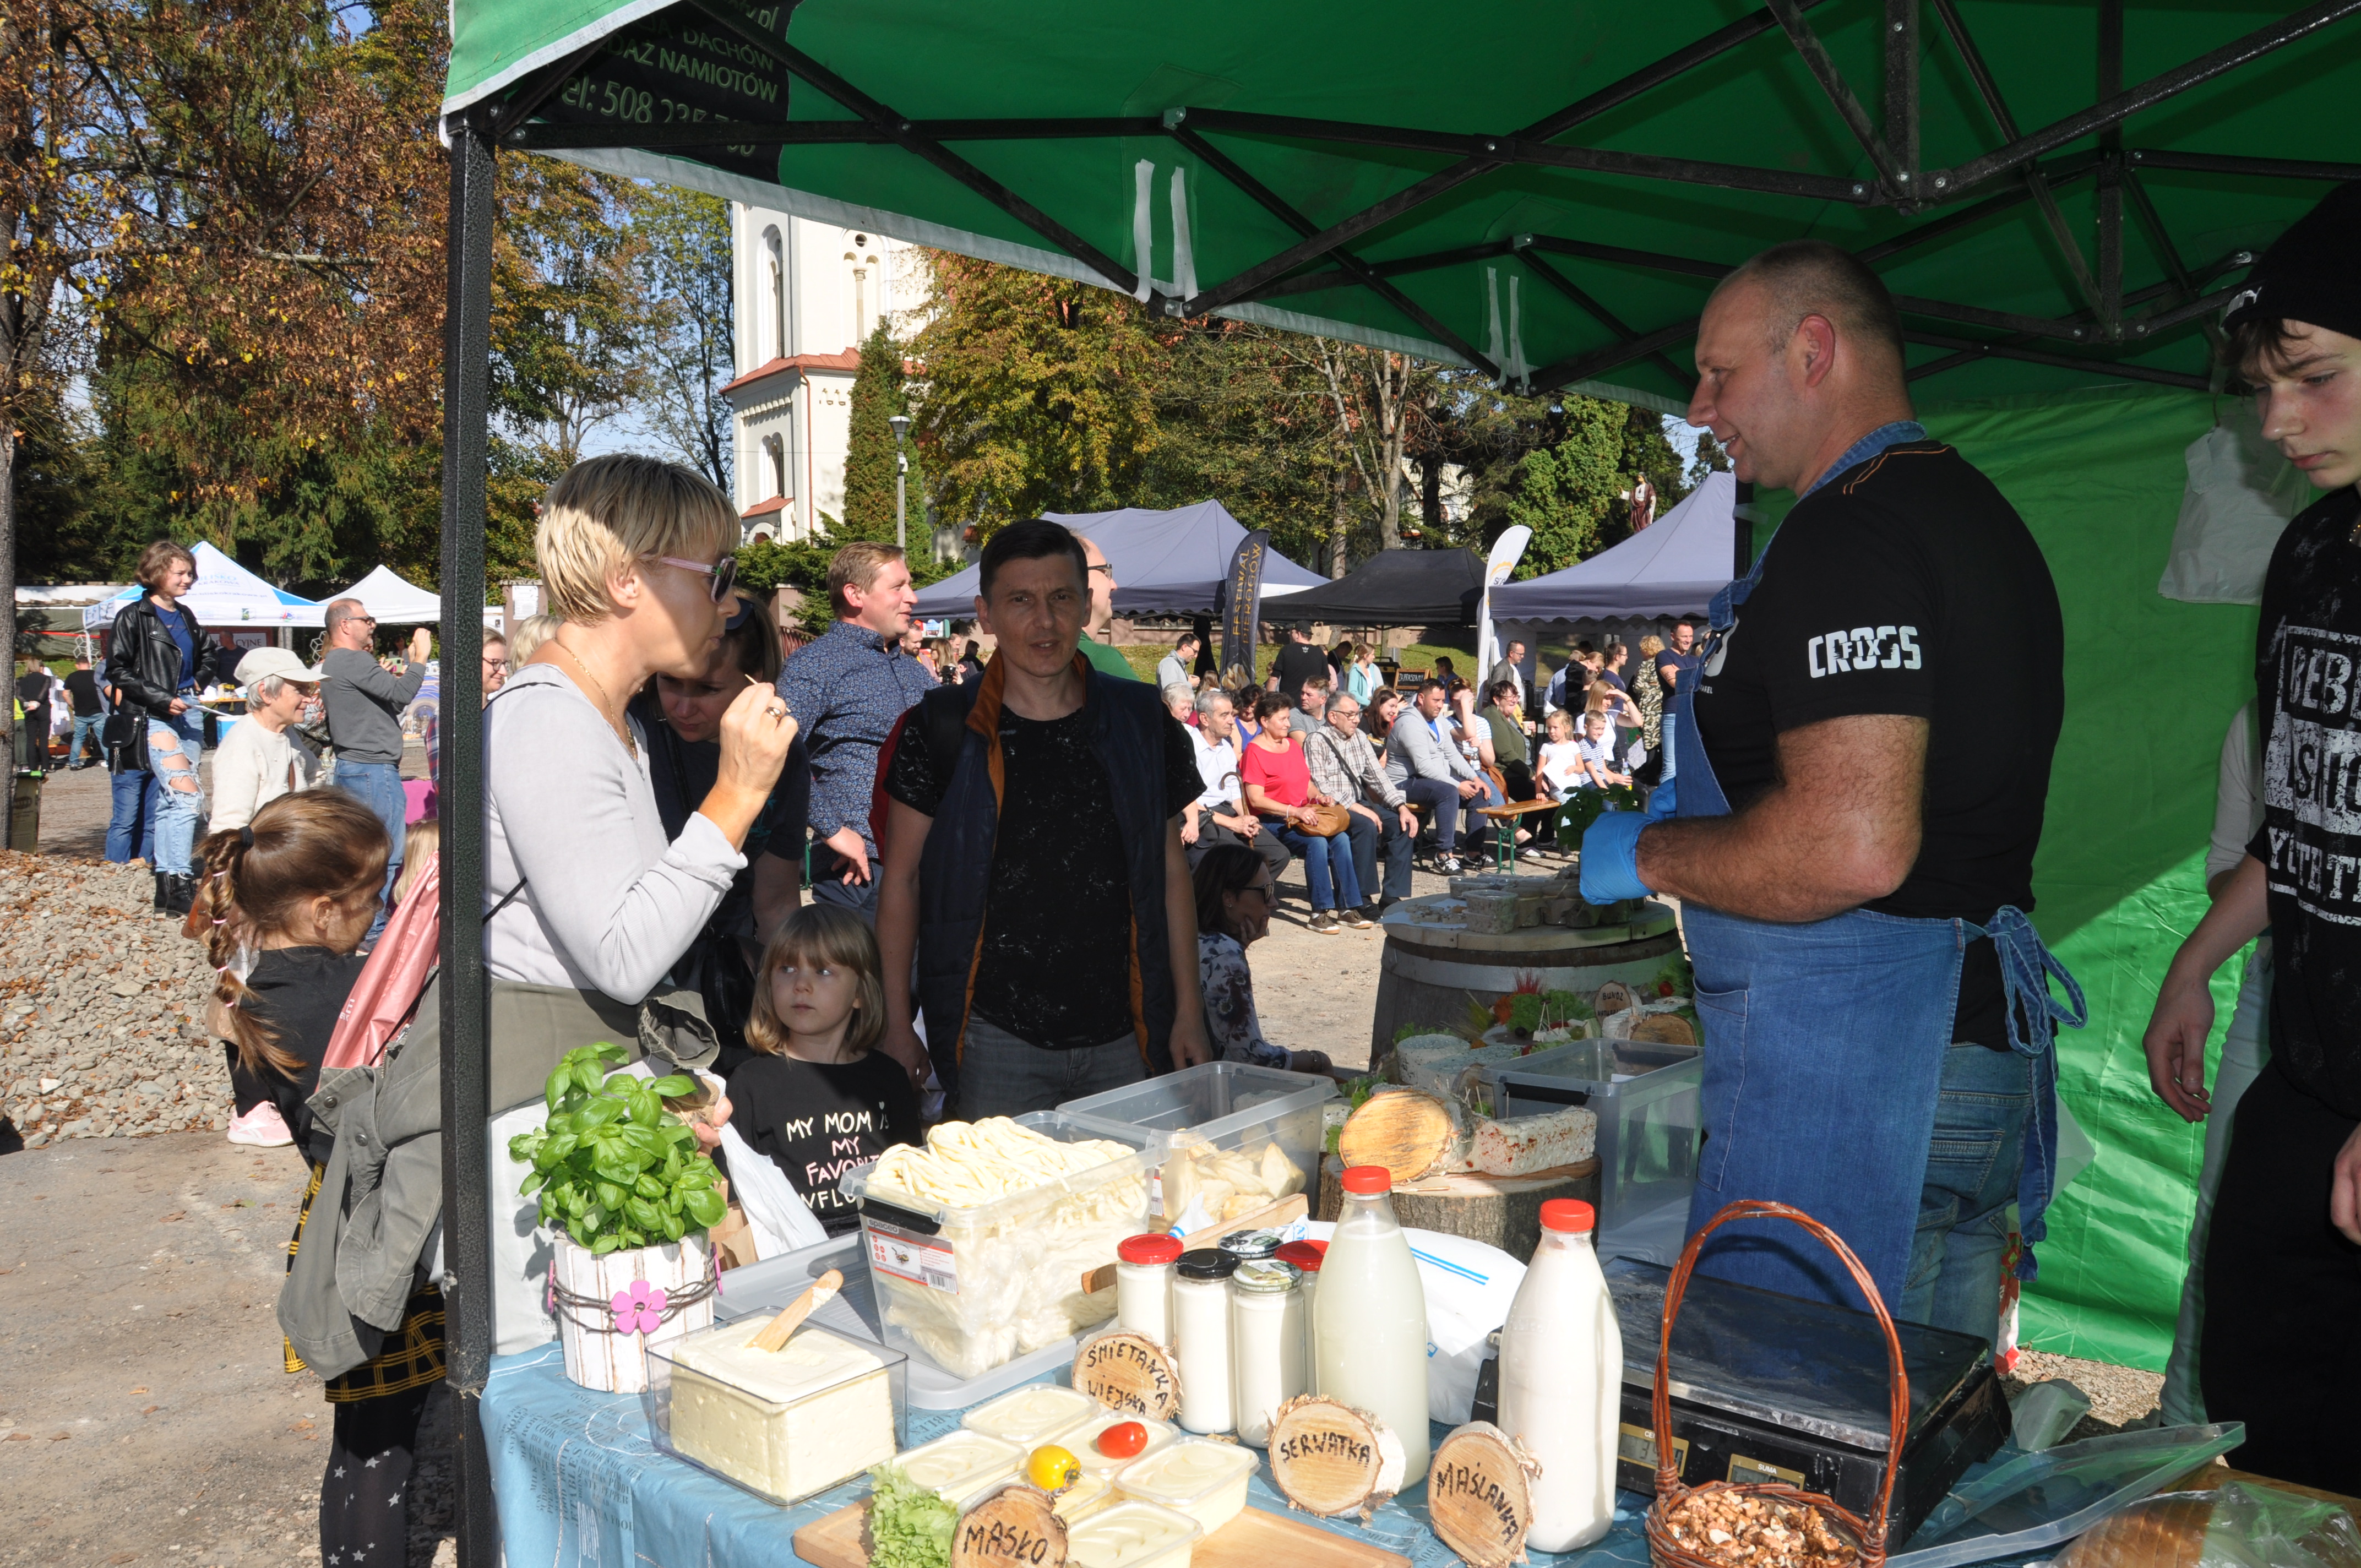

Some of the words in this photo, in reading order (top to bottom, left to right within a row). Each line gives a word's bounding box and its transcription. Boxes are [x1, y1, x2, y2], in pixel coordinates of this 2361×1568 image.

[605, 33, 655, 67] DAŻ
[660, 47, 778, 104] NAMIOTÓW
[683, 26, 774, 72] DACHÓW
[561, 72, 596, 111] el:
[600, 80, 654, 124] 508
[1232, 549, 1249, 635] FESTIWAL
[1242, 543, 1262, 644] PIEROGÓW
[1808, 625, 1922, 678] CROSS
[1842, 639, 1881, 659] FIX
[787, 1117, 814, 1142] MY
[825, 1110, 872, 1134] MOM
[831, 1136, 859, 1157] MY
[869, 1218, 898, 1233] spaceo
[535, 1423, 556, 1439] COOK
[1281, 1431, 1370, 1470] SERWATKA
[584, 1448, 603, 1462] COOK
[1758, 1463, 1777, 1475] SUMA
[568, 1446, 584, 1528] ETABLES
[608, 1477, 637, 1499] PUDDIG
[1437, 1462, 1520, 1546] MAŚLANKA
[964, 1520, 1049, 1565] MASŁO
